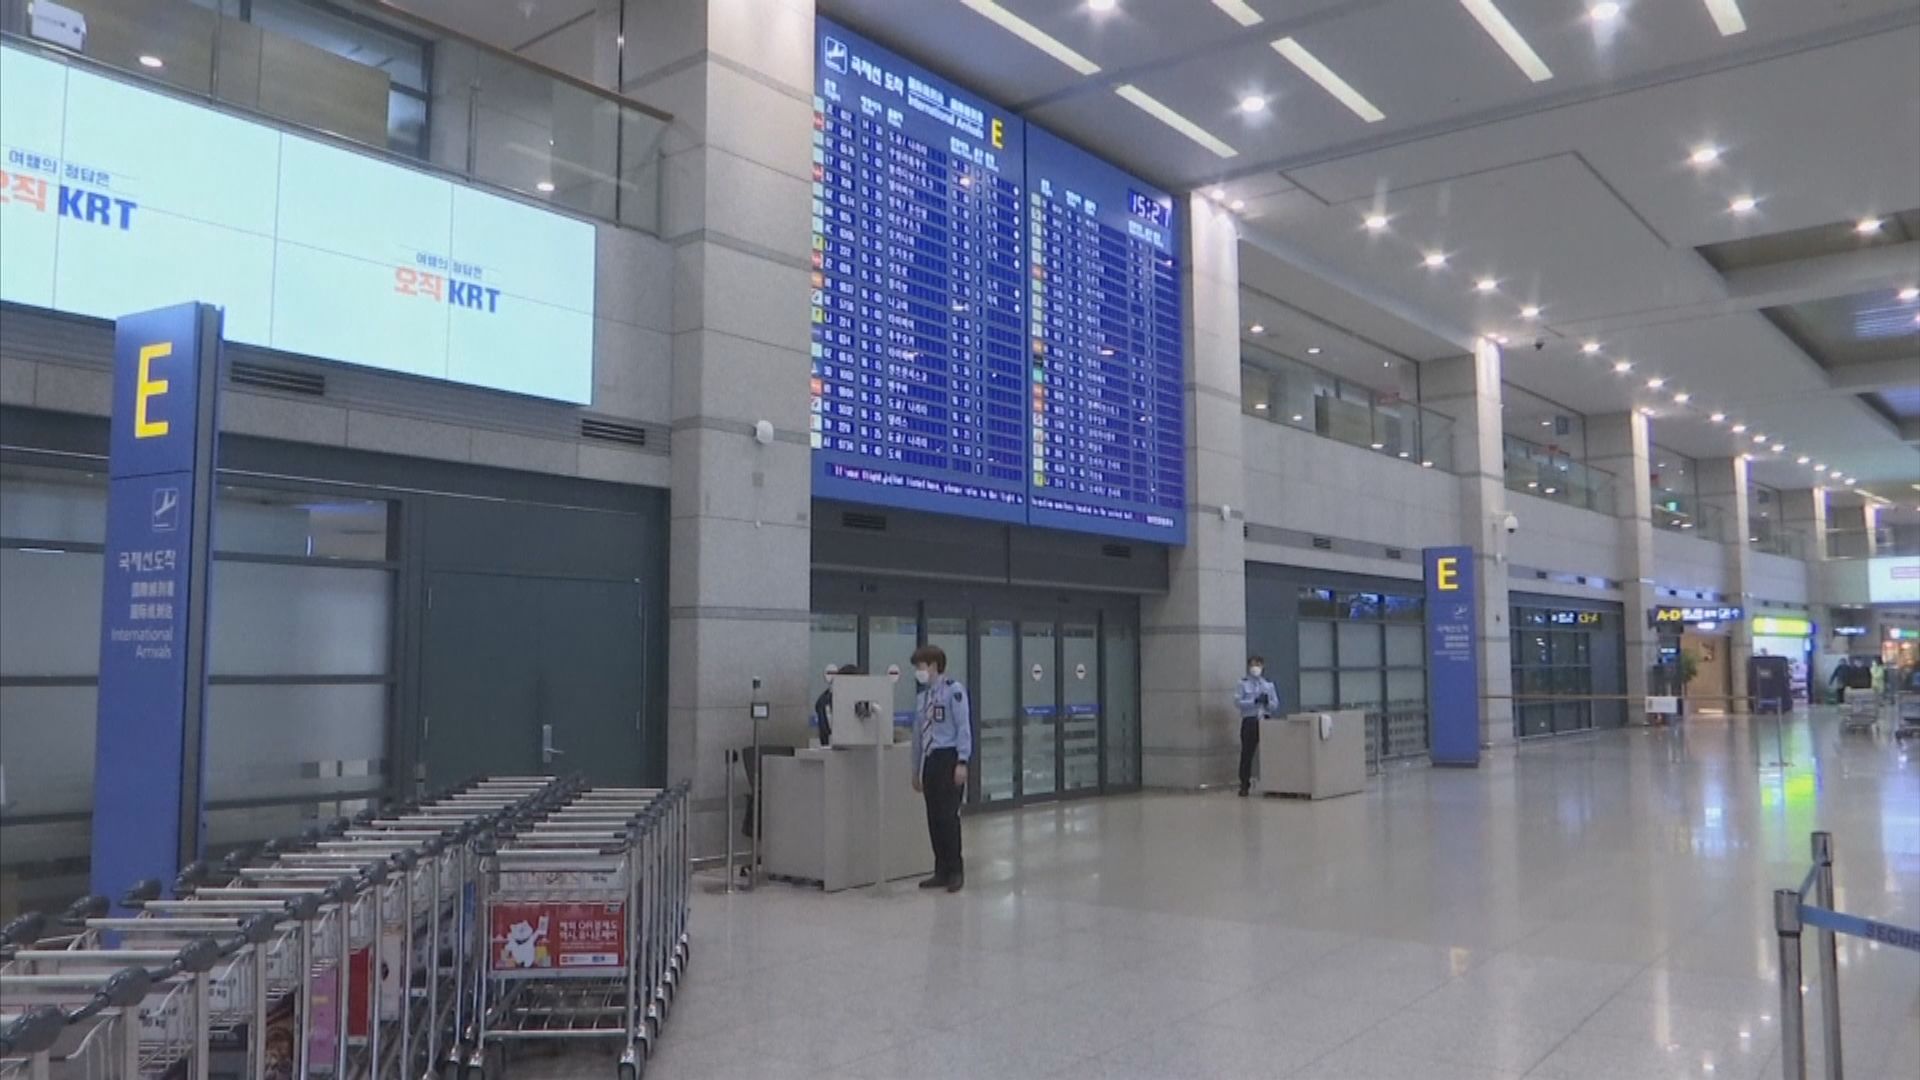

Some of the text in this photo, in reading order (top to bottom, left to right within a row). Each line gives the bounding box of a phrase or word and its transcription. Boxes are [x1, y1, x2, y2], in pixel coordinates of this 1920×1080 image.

[991, 118, 1003, 149] E
[58, 184, 138, 231] KRT
[394, 266, 501, 313] 오직 KRT
[135, 342, 173, 439] E
[1437, 557, 1459, 590] E
[111, 627, 173, 641] International
[136, 645, 171, 659] Arrivals
